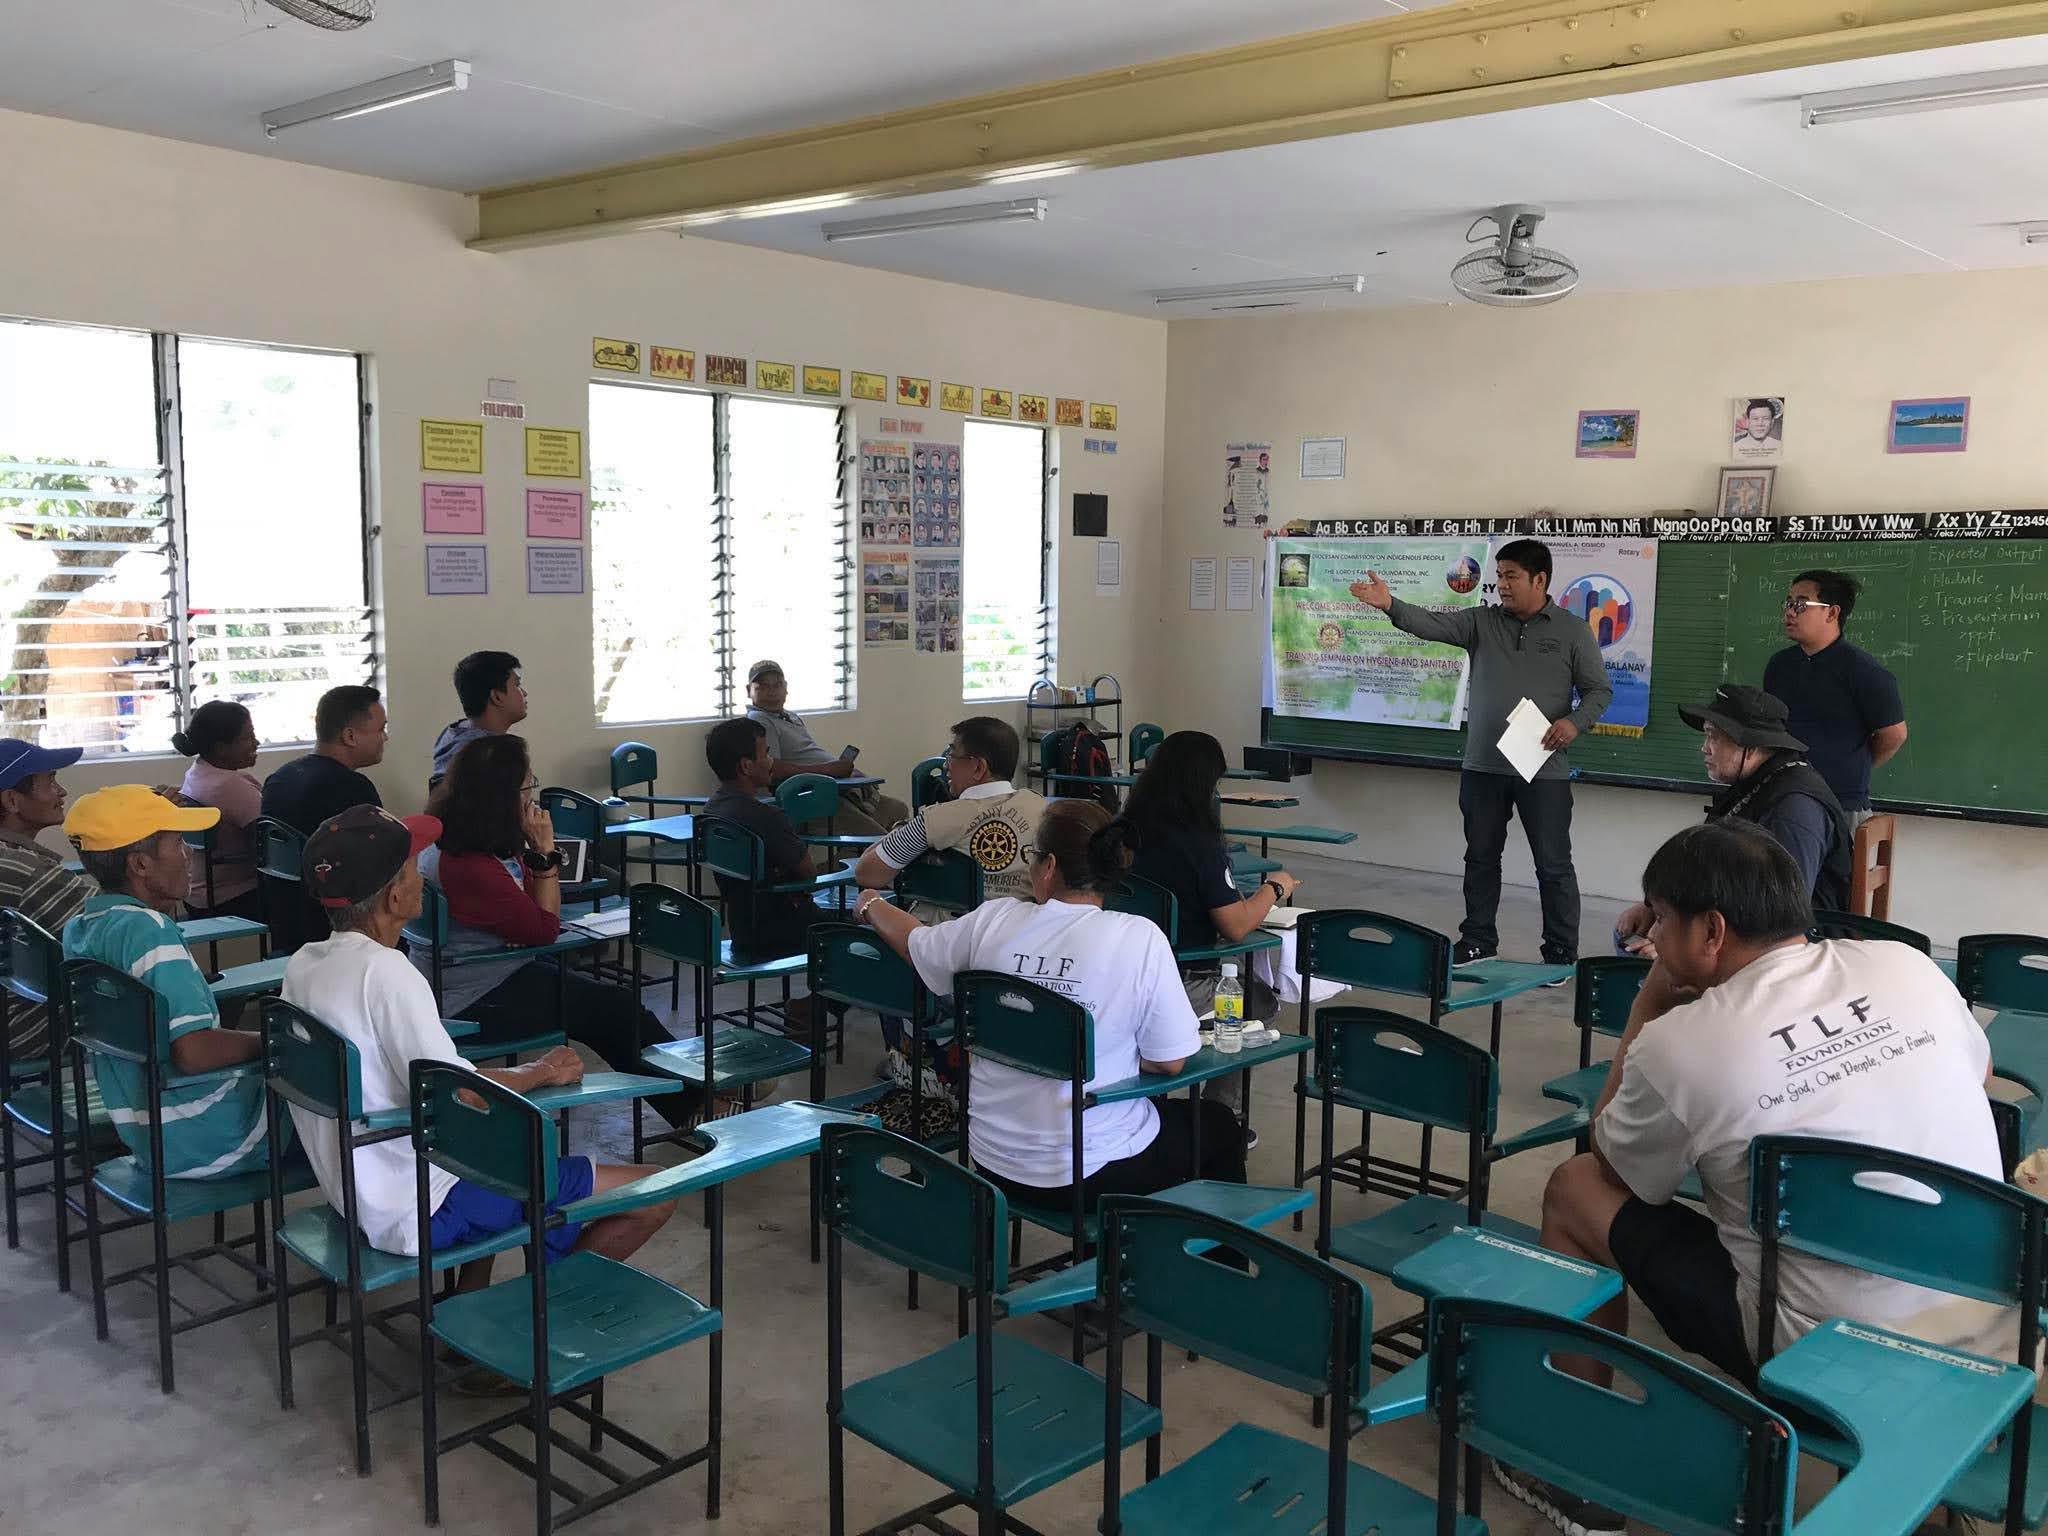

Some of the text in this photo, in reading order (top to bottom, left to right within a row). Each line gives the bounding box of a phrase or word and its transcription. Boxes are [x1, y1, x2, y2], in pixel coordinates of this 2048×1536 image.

[484, 403, 523, 418] FILIPINO
[1316, 520, 1408, 534] Aa Bb Cc Dd Ee
[1423, 519, 1434, 534] Ff
[1443, 520, 1459, 536] Gg
[1465, 519, 1481, 533] Hh
[1535, 519, 1550, 533] Kk
[1573, 519, 1596, 533] Mm
[1601, 519, 1618, 533] Nn
[1689, 517, 1710, 532] Oo
[1711, 517, 1730, 535] Pp
[1731, 517, 1752, 536] Qq
[1755, 517, 1772, 532] Rr
[1788, 514, 1914, 531] Ss Tt Uu Vv Ww
[1937, 513, 1959, 527] Xx
[1966, 512, 1985, 531] Yy
[1990, 511, 2012, 527] Zz
[1618, 549, 1640, 557] Rotary
[1285, 652, 1465, 669] TRAINING SEMINAR ON HYGIENE AND SANITATION
[1605, 661, 1645, 672] BALANAY
[1005, 806, 1030, 834] CLUB
[1785, 1022, 1893, 1071] FOUNDATION
[1758, 1029, 1937, 1110] One God, One People, One Family
